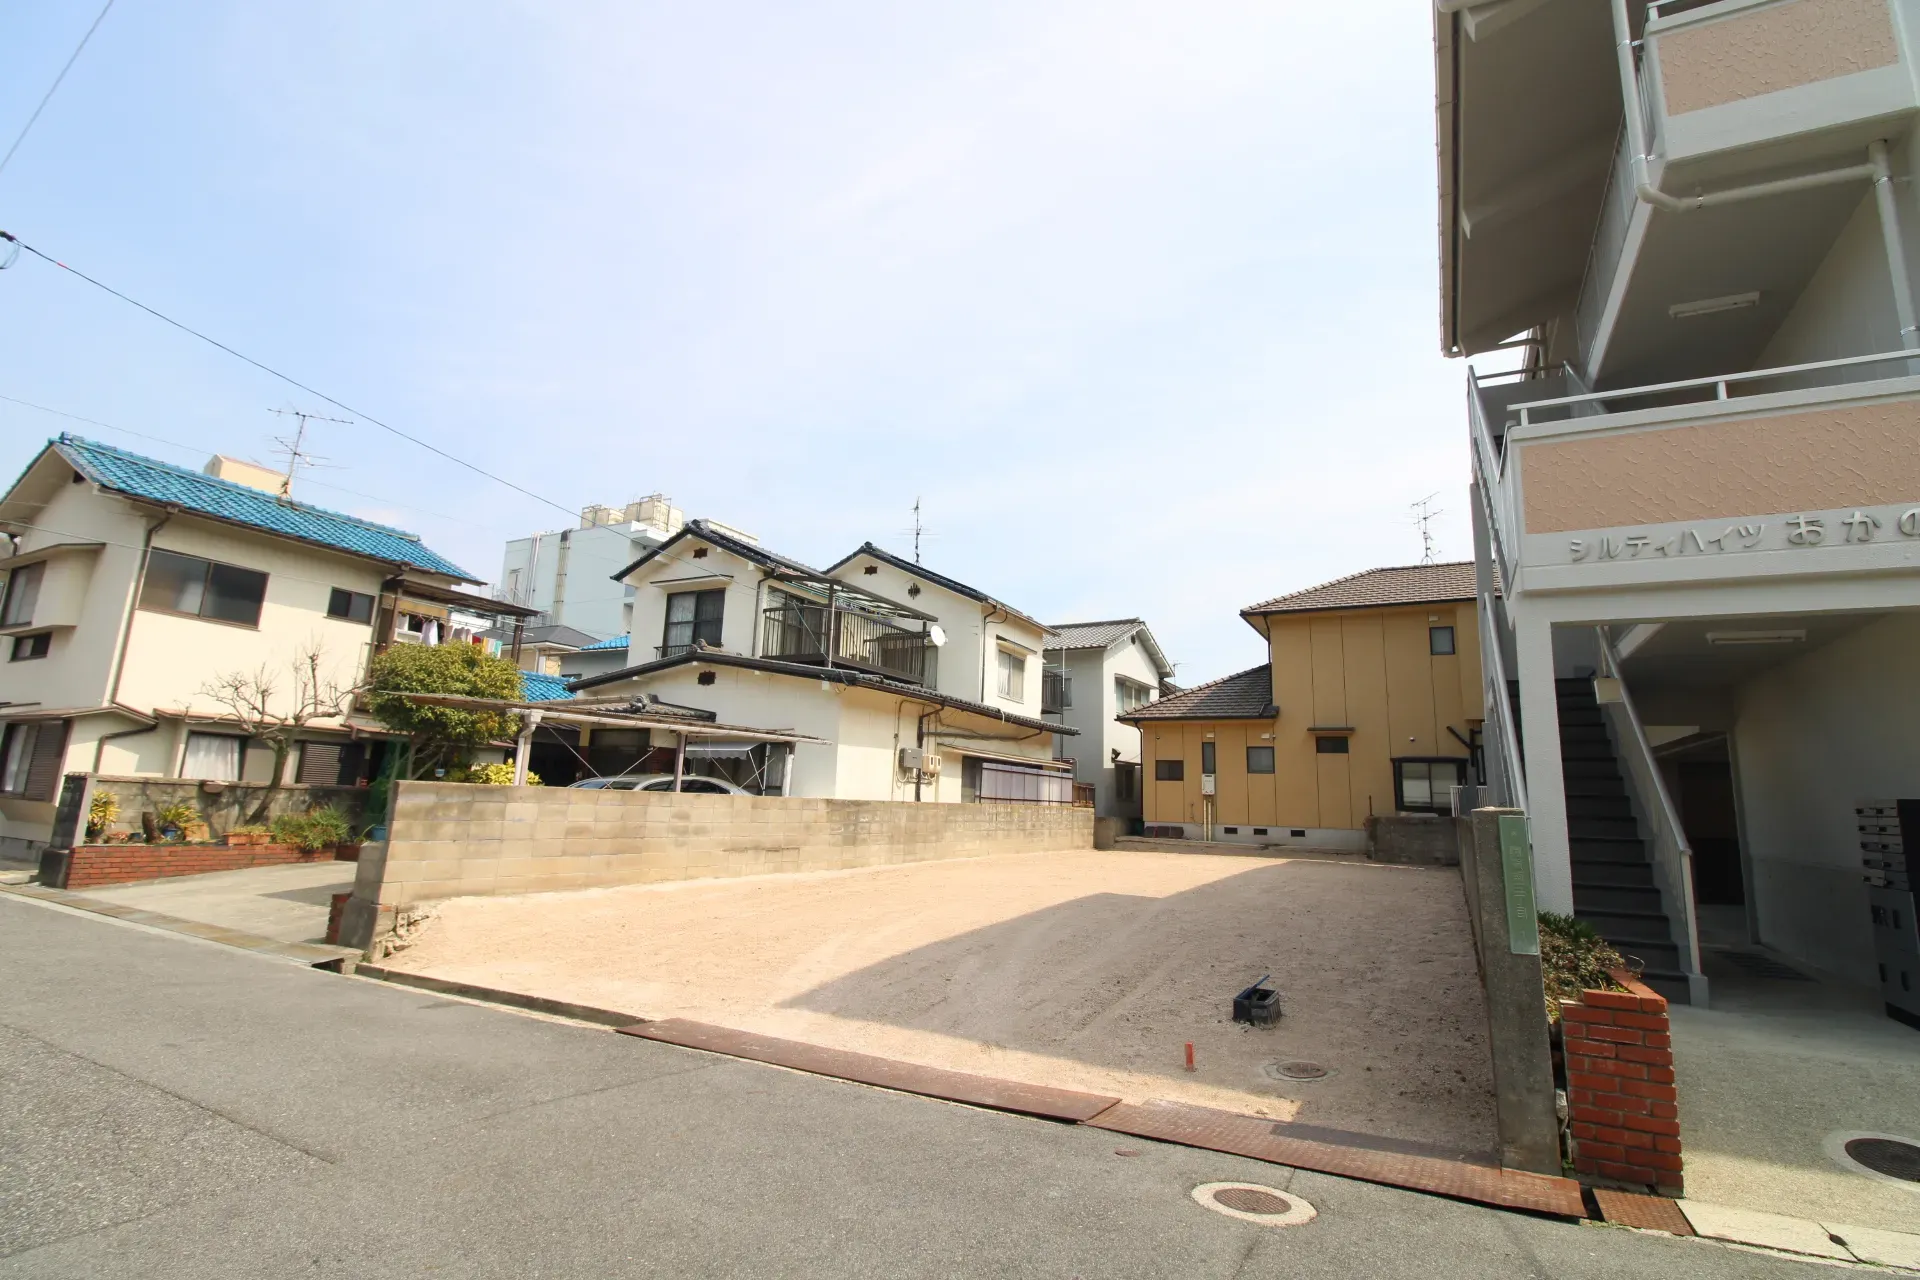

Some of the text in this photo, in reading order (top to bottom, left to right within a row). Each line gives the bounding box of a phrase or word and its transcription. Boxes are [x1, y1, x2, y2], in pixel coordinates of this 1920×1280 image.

[1570, 524, 1765, 561] シルティハイツ
